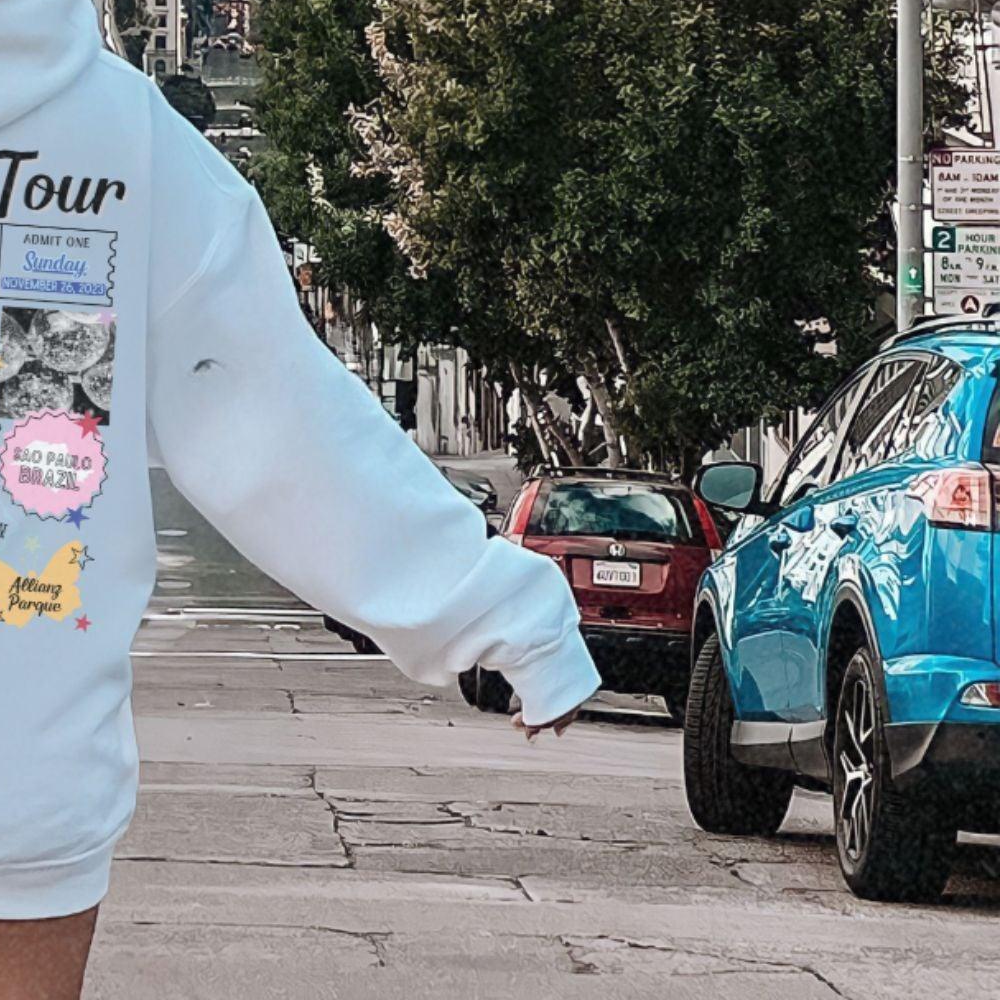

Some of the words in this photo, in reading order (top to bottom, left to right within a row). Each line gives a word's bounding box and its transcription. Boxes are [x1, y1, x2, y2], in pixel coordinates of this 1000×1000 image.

[932, 153, 952, 165] NO
[23, 233, 62, 246] ADMIT
[66, 236, 91, 249] ONE
[937, 230, 951, 249] 2
[965, 234, 996, 242] HOUR
[3, 277, 57, 292] NOVEMBER
[78, 283, 106, 296] 2023
[46, 451, 93, 471] PAULO
[19, 465, 80, 491] BRAZIL
[9, 576, 63, 600] Allianz
[8, 592, 62, 617] Parque
